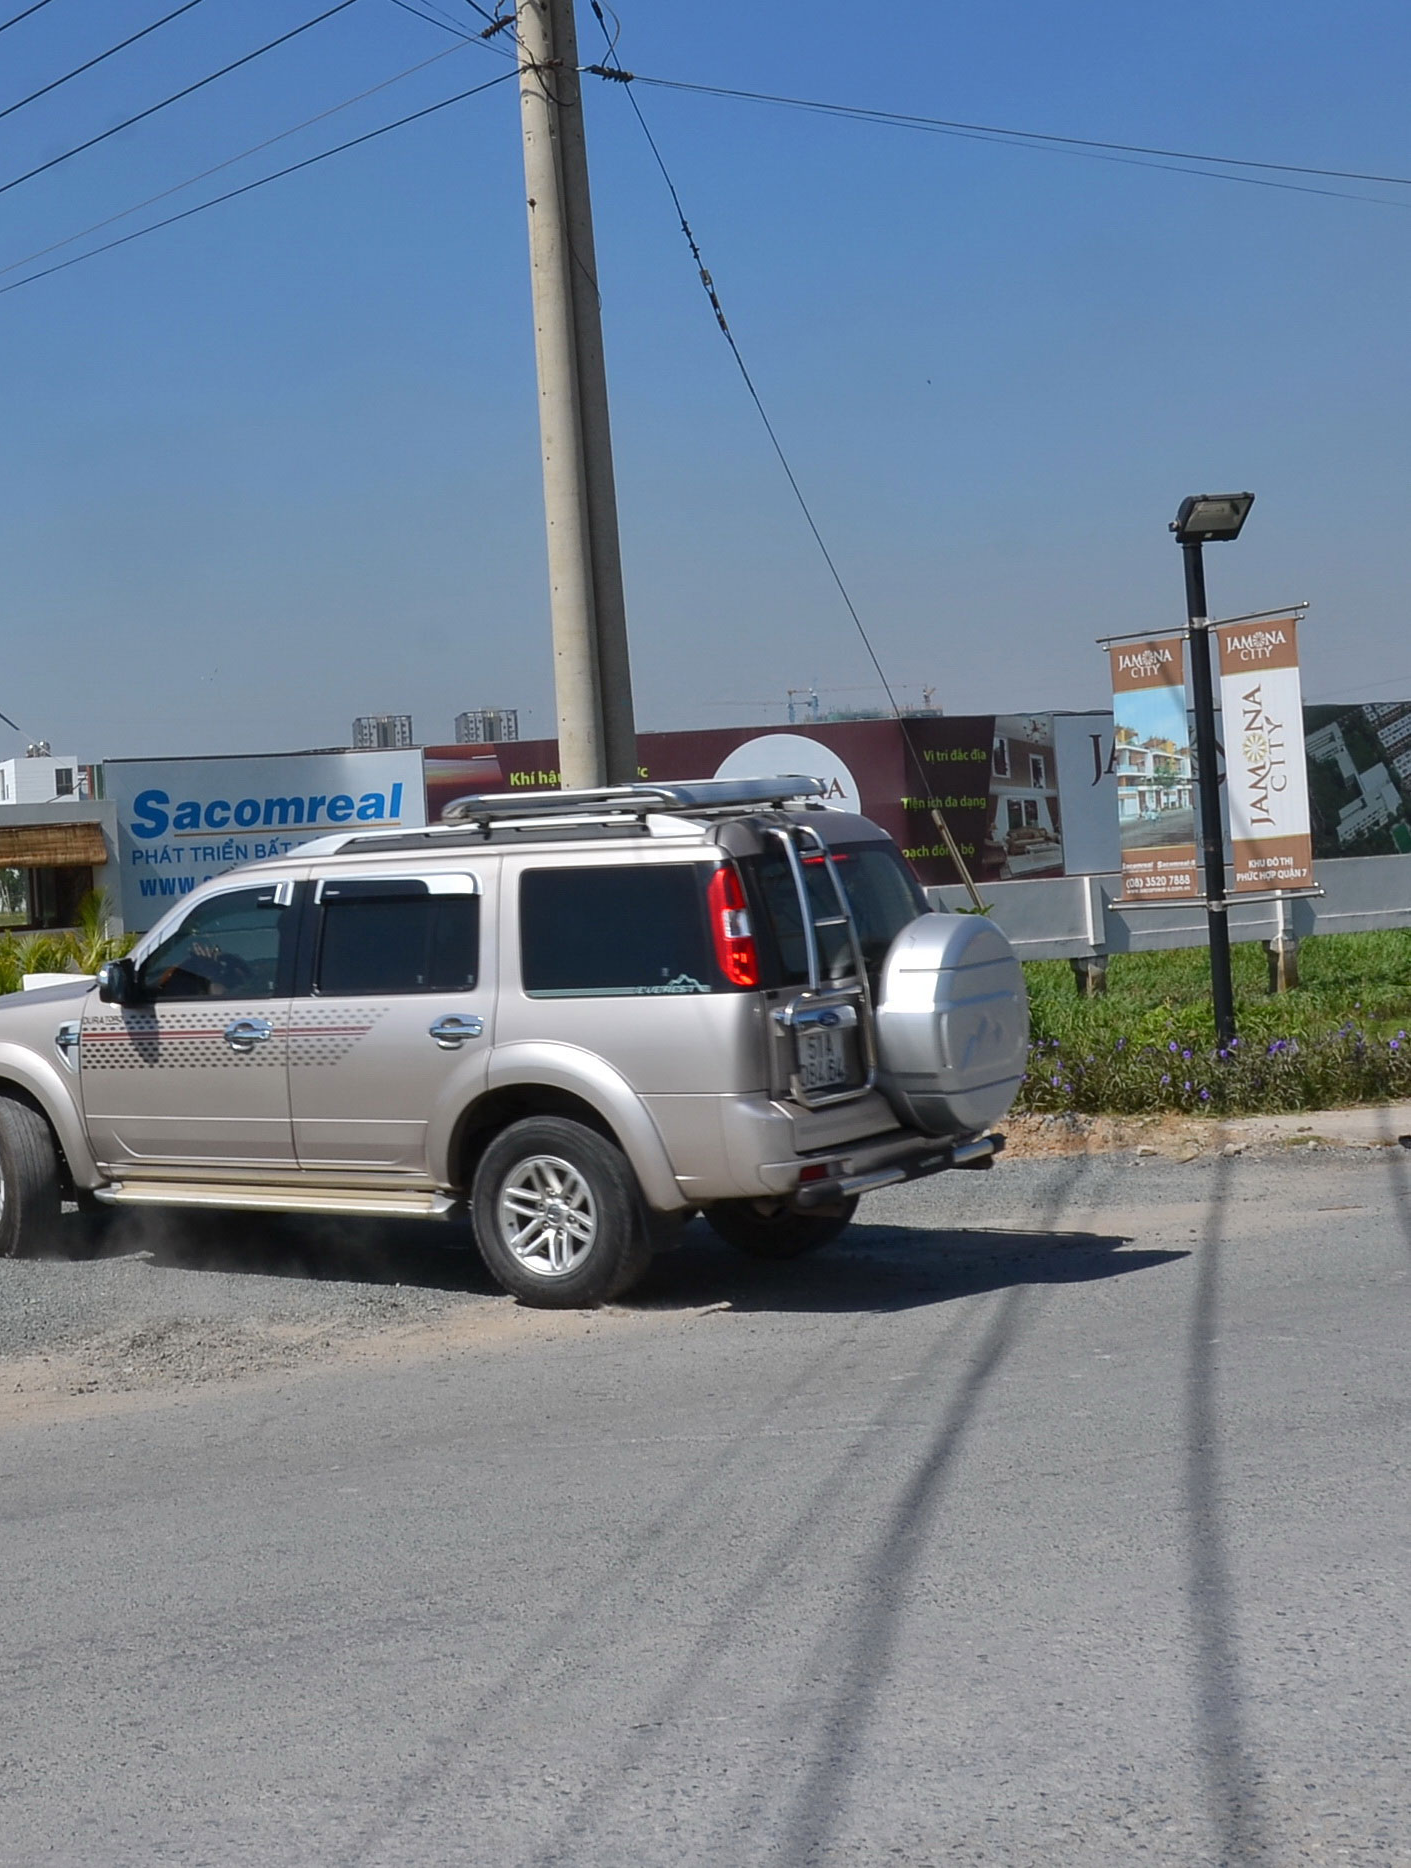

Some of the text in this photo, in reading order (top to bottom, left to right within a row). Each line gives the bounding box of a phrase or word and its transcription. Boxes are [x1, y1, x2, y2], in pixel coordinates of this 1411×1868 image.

[1240, 645, 1273, 661] CITY
[1131, 663, 1161, 678] CITY
[1264, 715, 1287, 792] CITY
[510, 771, 535, 786] Khí
[960, 795, 987, 809] dạng
[130, 783, 403, 839] Sacomreal
[132, 847, 184, 865] PHÁT
[190, 838, 247, 863] TRIỂN
[901, 845, 930, 860] oạch
[1301, 868, 1308, 877] 7
[1145, 875, 1167, 887] 3520
